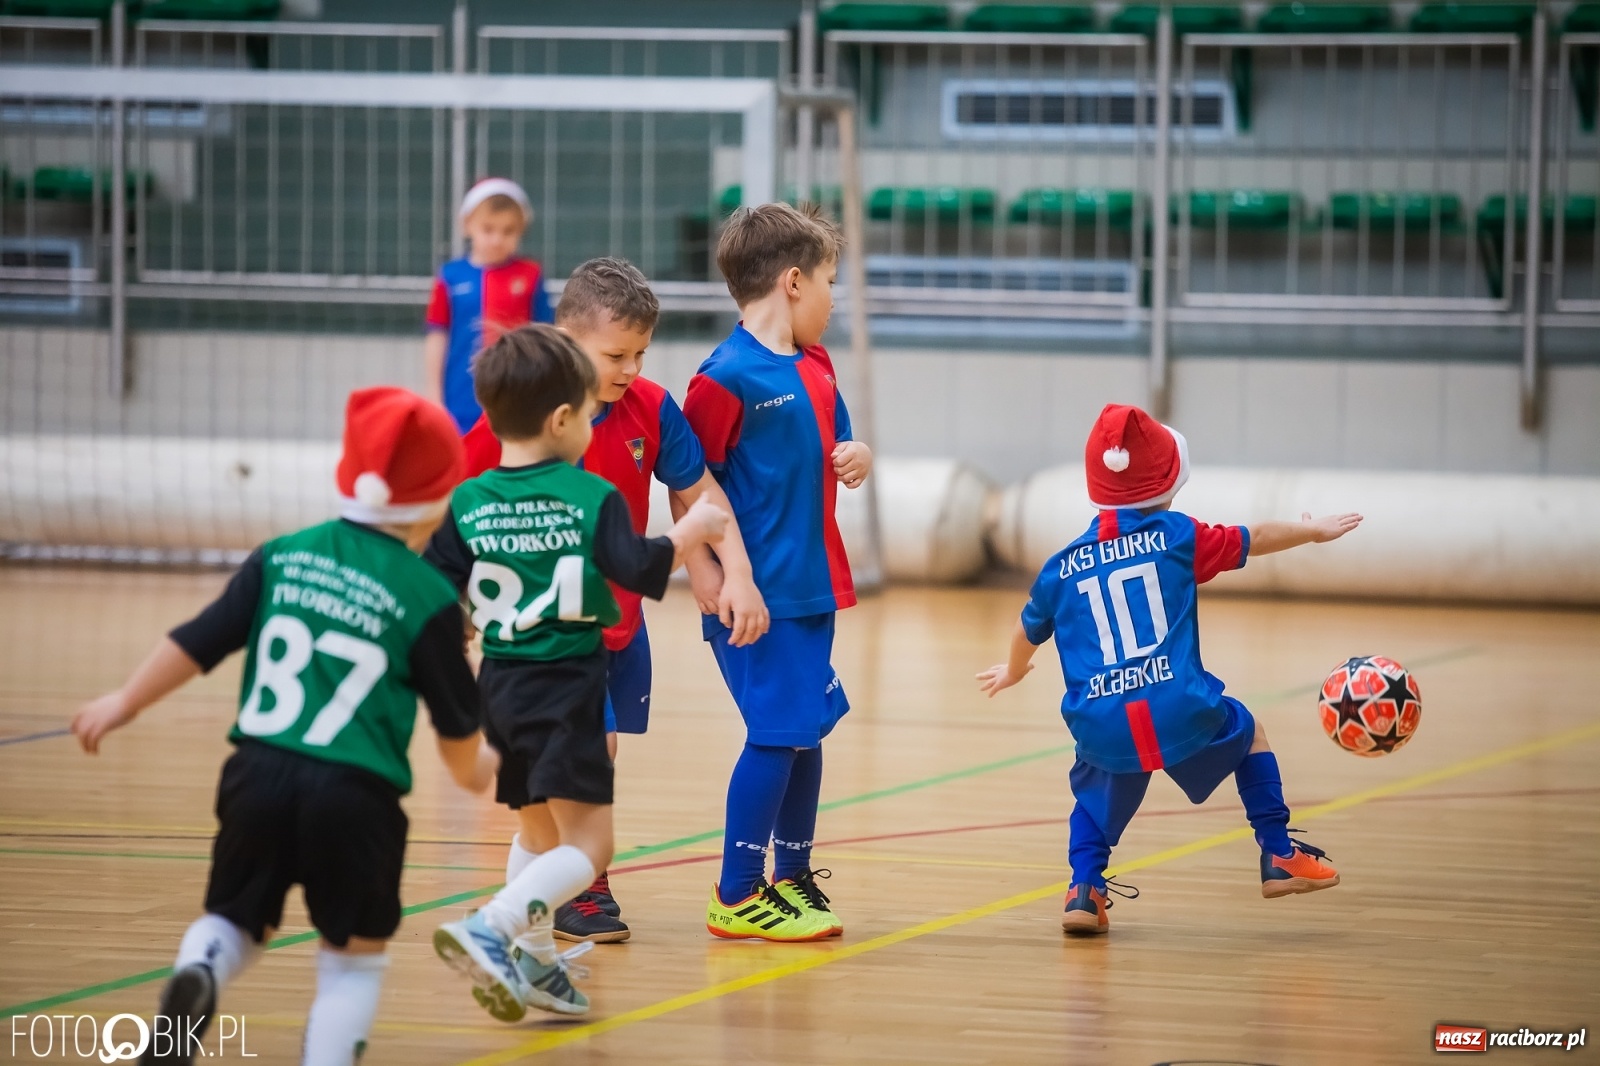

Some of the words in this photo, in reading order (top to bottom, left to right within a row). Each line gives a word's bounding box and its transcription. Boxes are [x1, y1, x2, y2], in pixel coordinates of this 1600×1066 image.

[755, 393, 795, 410] regio
[467, 526, 582, 556] TWORKÓW
[467, 555, 597, 641] 84
[1076, 561, 1169, 666] 10
[238, 614, 388, 747] 87
[735, 841, 768, 854] reg
